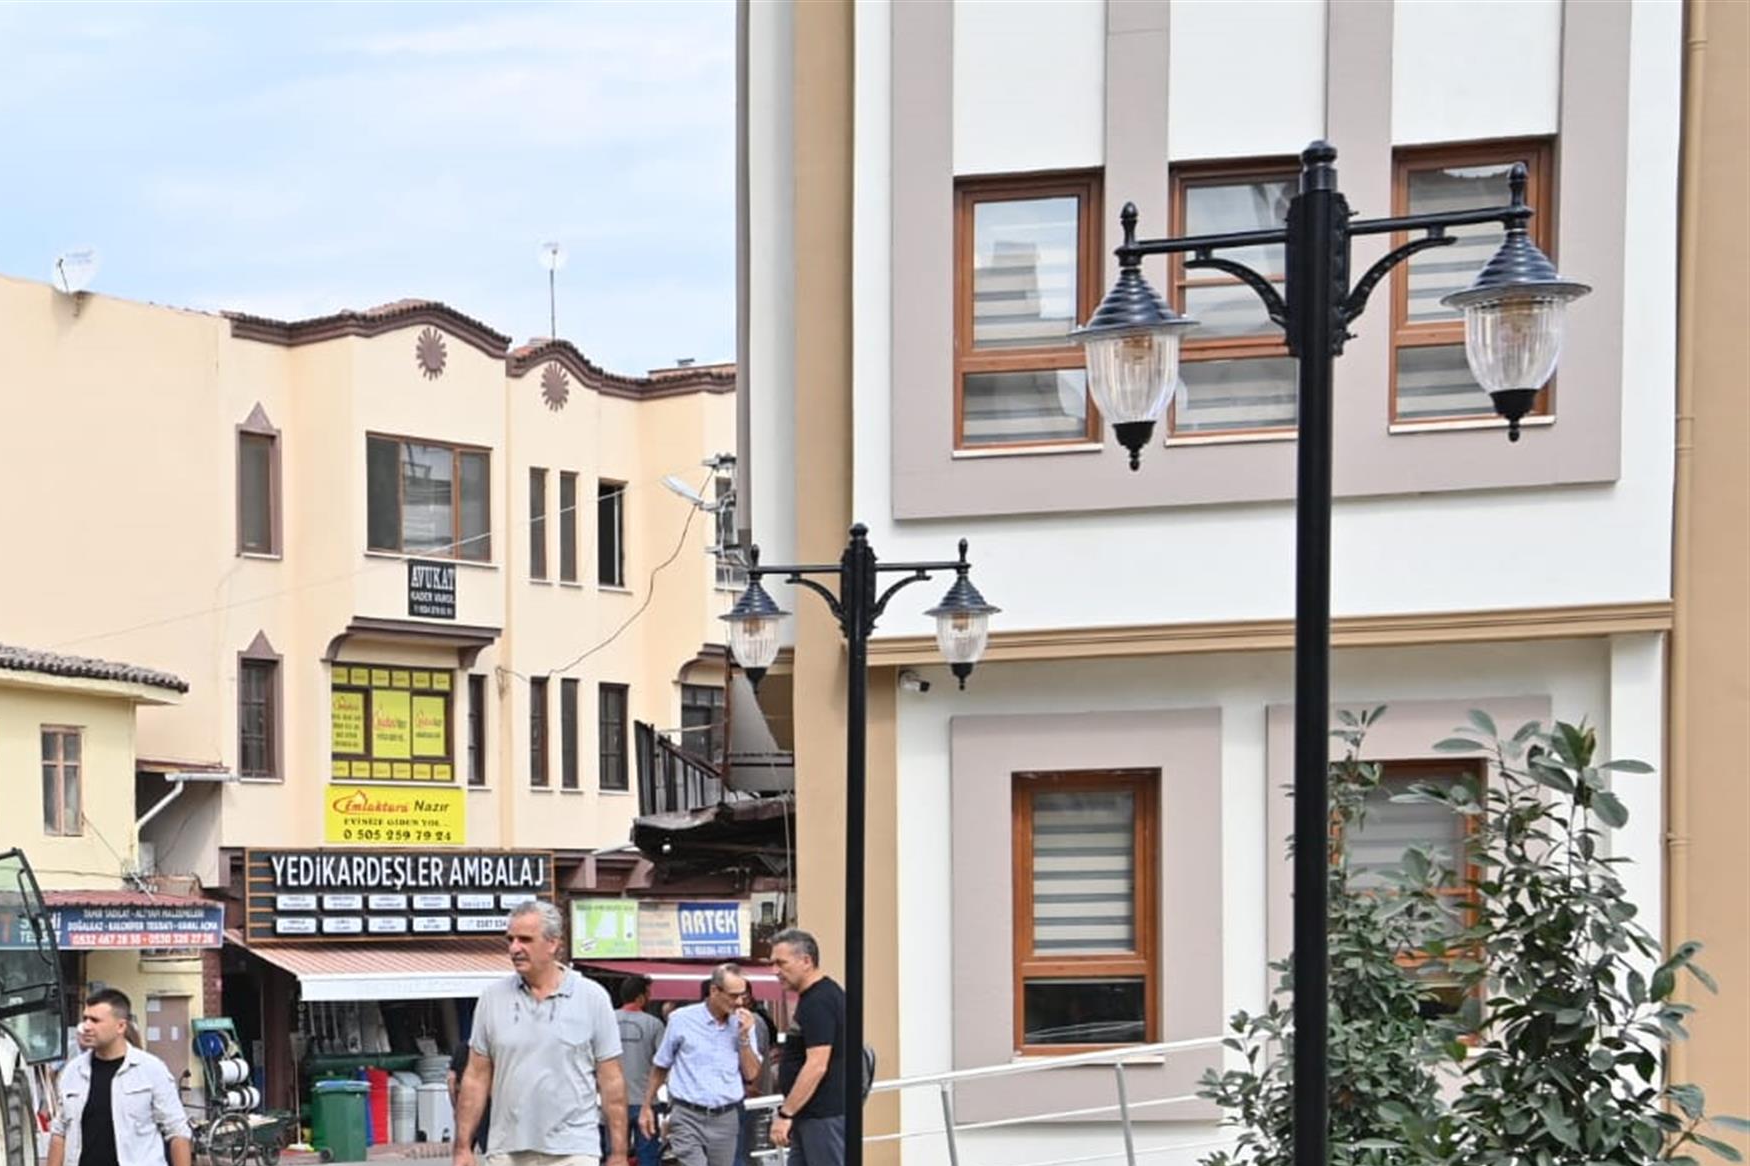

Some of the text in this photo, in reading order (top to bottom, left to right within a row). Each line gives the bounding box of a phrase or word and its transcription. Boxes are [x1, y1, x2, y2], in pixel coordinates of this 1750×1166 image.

[411, 565, 453, 590] AVUKAT
[271, 856, 545, 890] YEDİKARDEŞLER AMBALAJ
[680, 909, 738, 935] ARTEK
